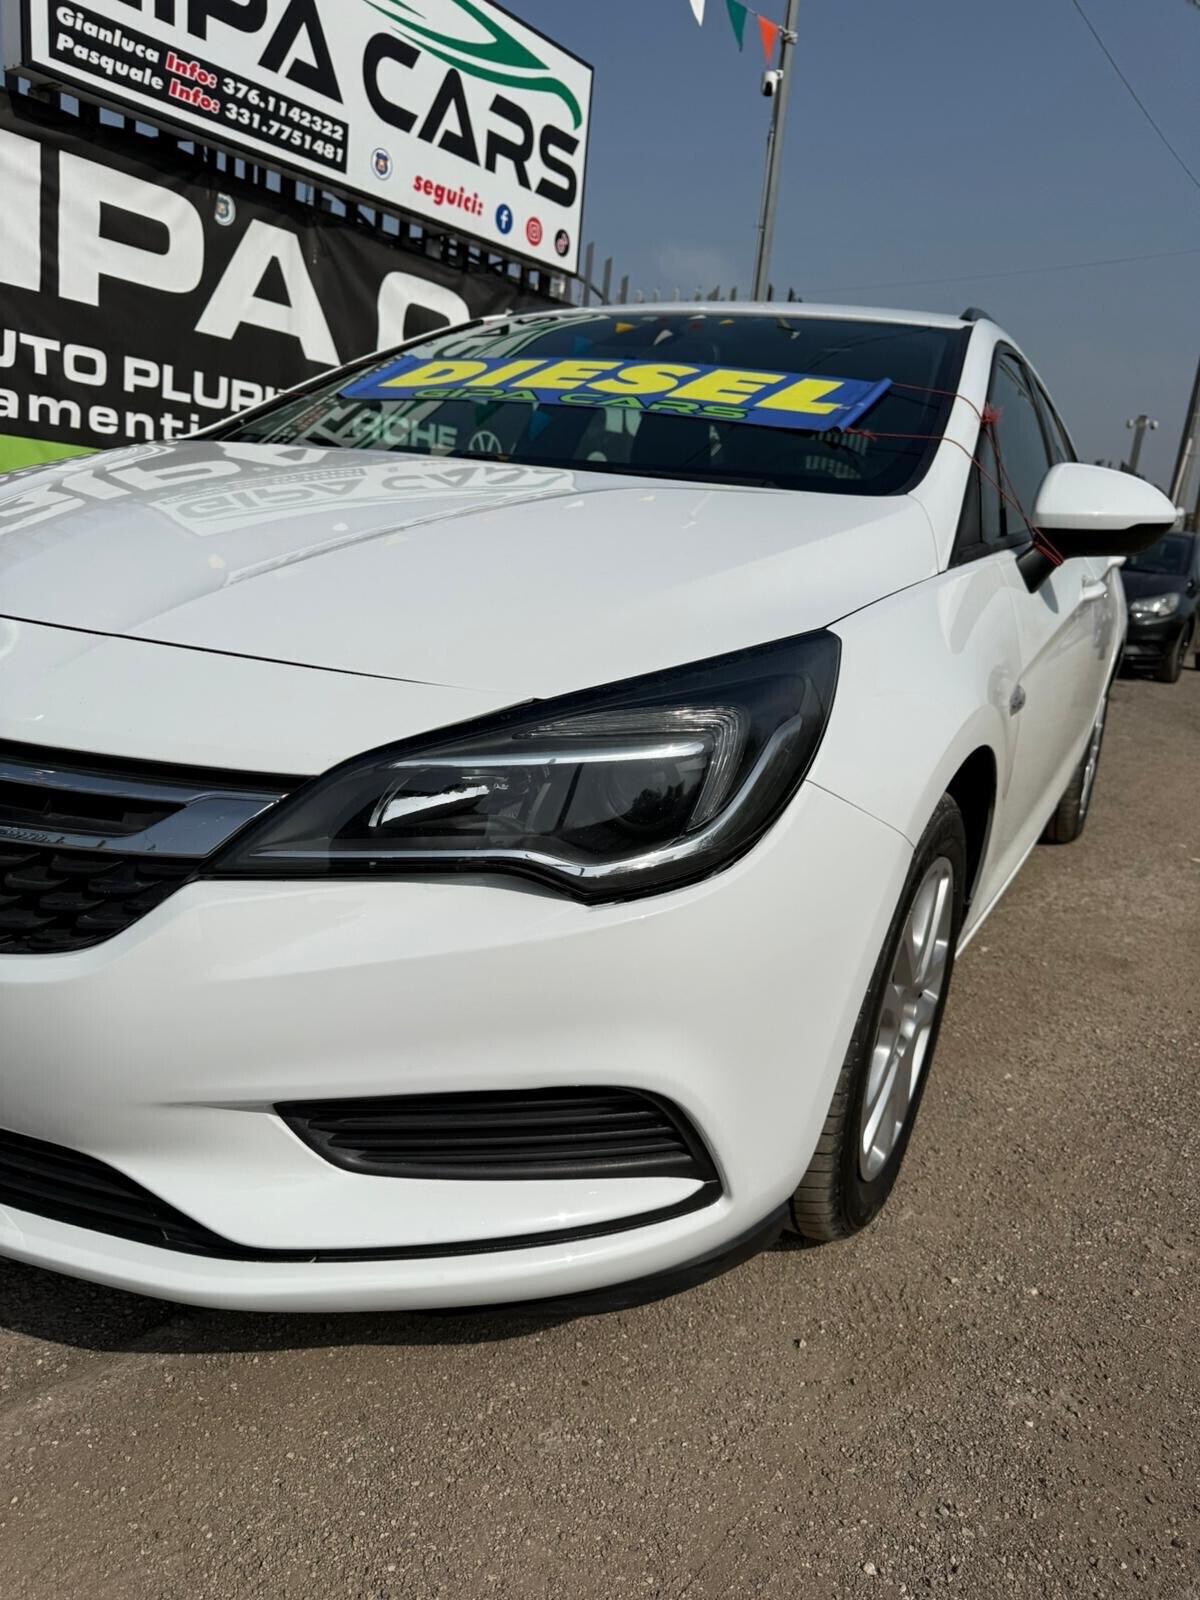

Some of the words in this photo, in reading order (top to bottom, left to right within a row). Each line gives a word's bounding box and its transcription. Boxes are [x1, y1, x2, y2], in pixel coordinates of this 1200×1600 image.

[56, 6, 159, 63] Gianluca
[165, 51, 218, 88] Info:
[223, 77, 344, 140] 376.1142322
[56, 33, 163, 90] Pasquale
[168, 78, 220, 113] Info:
[225, 103, 344, 162] 331.7751481
[363, 32, 580, 208] CARS
[413, 175, 483, 216] seguici:
[378, 360, 845, 415] DIESEL
[413, 388, 539, 401] GIPA
[561, 393, 750, 419] CARS
